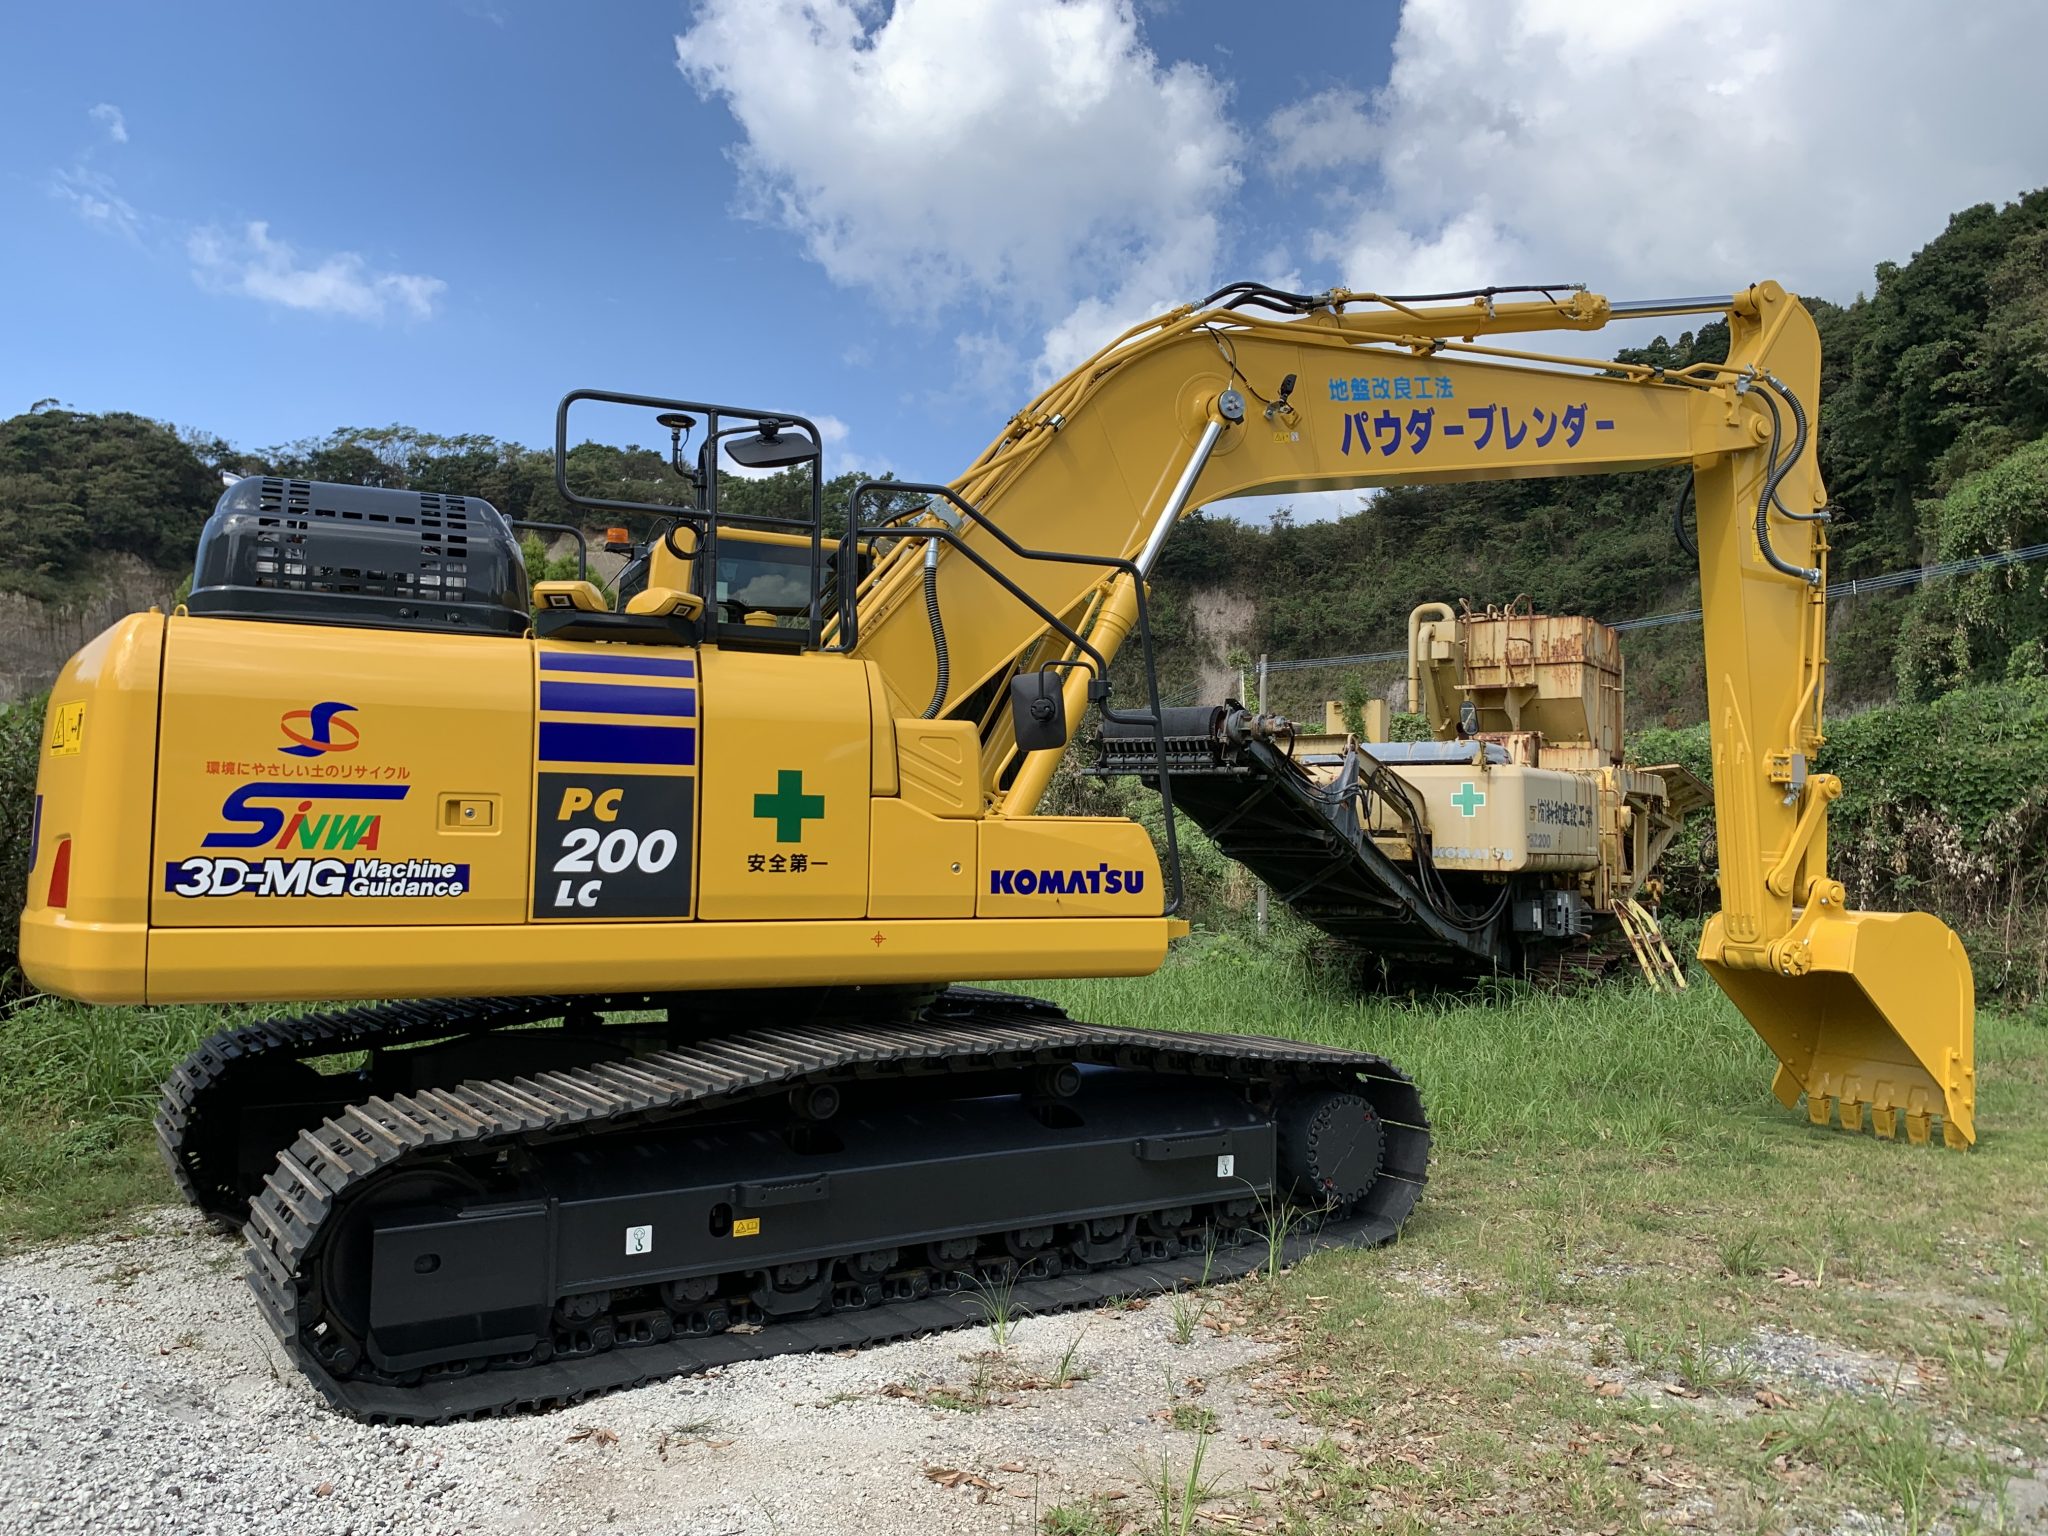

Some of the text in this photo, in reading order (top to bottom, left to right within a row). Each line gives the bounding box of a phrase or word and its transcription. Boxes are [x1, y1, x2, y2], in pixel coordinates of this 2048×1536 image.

[1328, 376, 1455, 402] 地盤改良工法
[1341, 402, 1616, 457] パウダーブレンダー
[206, 760, 411, 780] 環境にやさしい土のリサイクル
[557, 787, 624, 822] PC
[552, 828, 678, 873] 200
[747, 853, 828, 873] 安全第一
[173, 857, 457, 897] 3D-MG Machine
[349, 878, 464, 897] Guidance
[990, 863, 1144, 895] KOMATSU
[554, 880, 602, 907] LC
